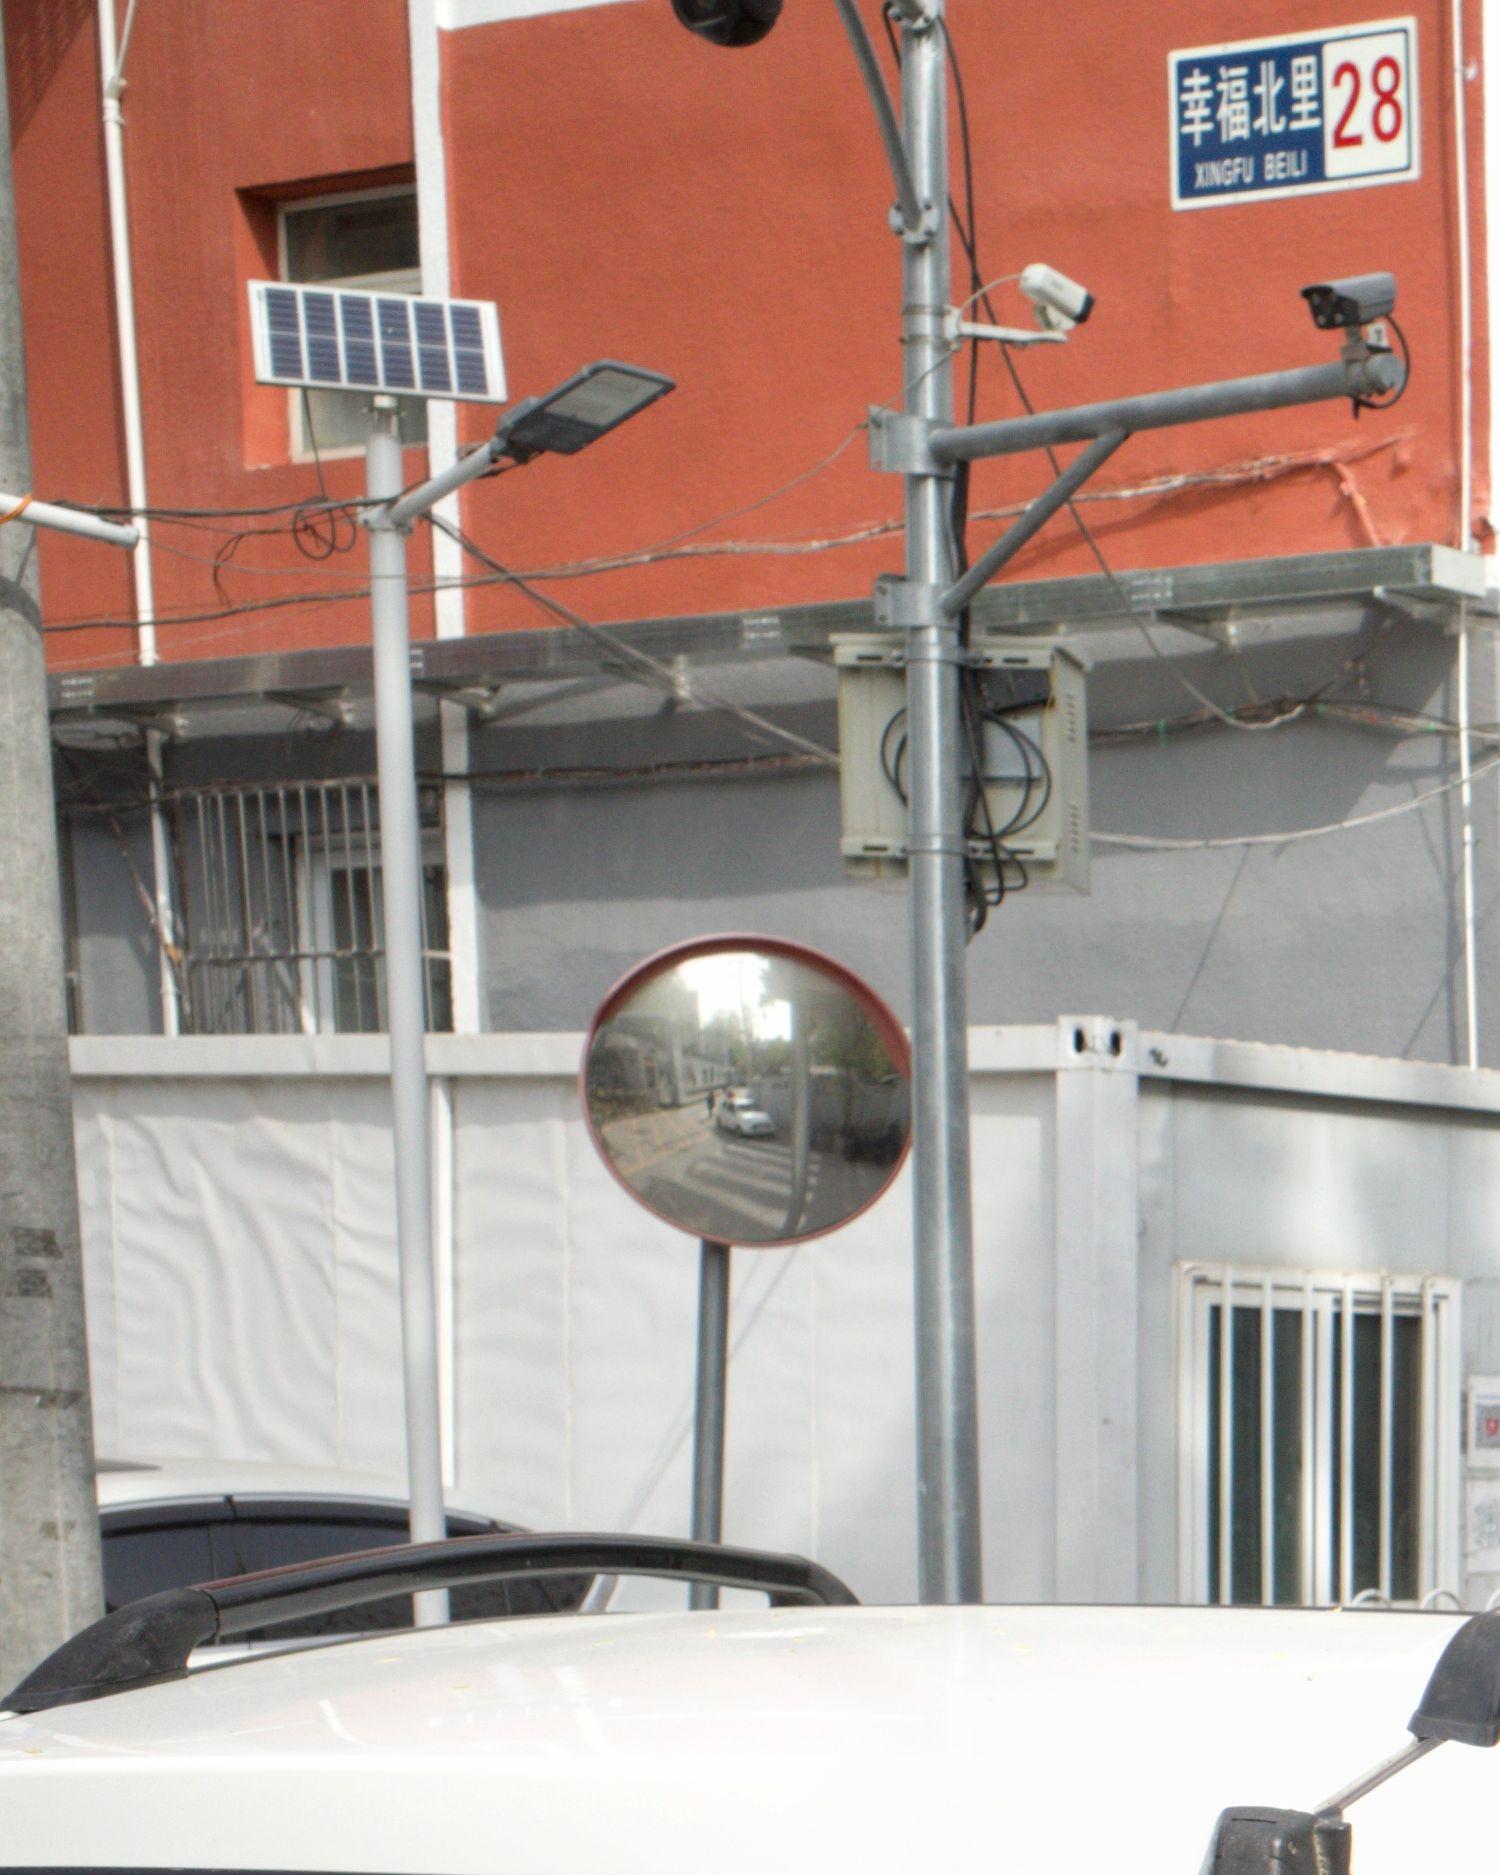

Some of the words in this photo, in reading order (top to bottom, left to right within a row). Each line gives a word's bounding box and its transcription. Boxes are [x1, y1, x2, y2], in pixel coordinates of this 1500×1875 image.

[1180, 55, 1321, 146] 幸福北里
[1332, 56, 1403, 148] 28
[1195, 156, 1254, 188] XINGFU
[1264, 150, 1308, 181] BEILI
